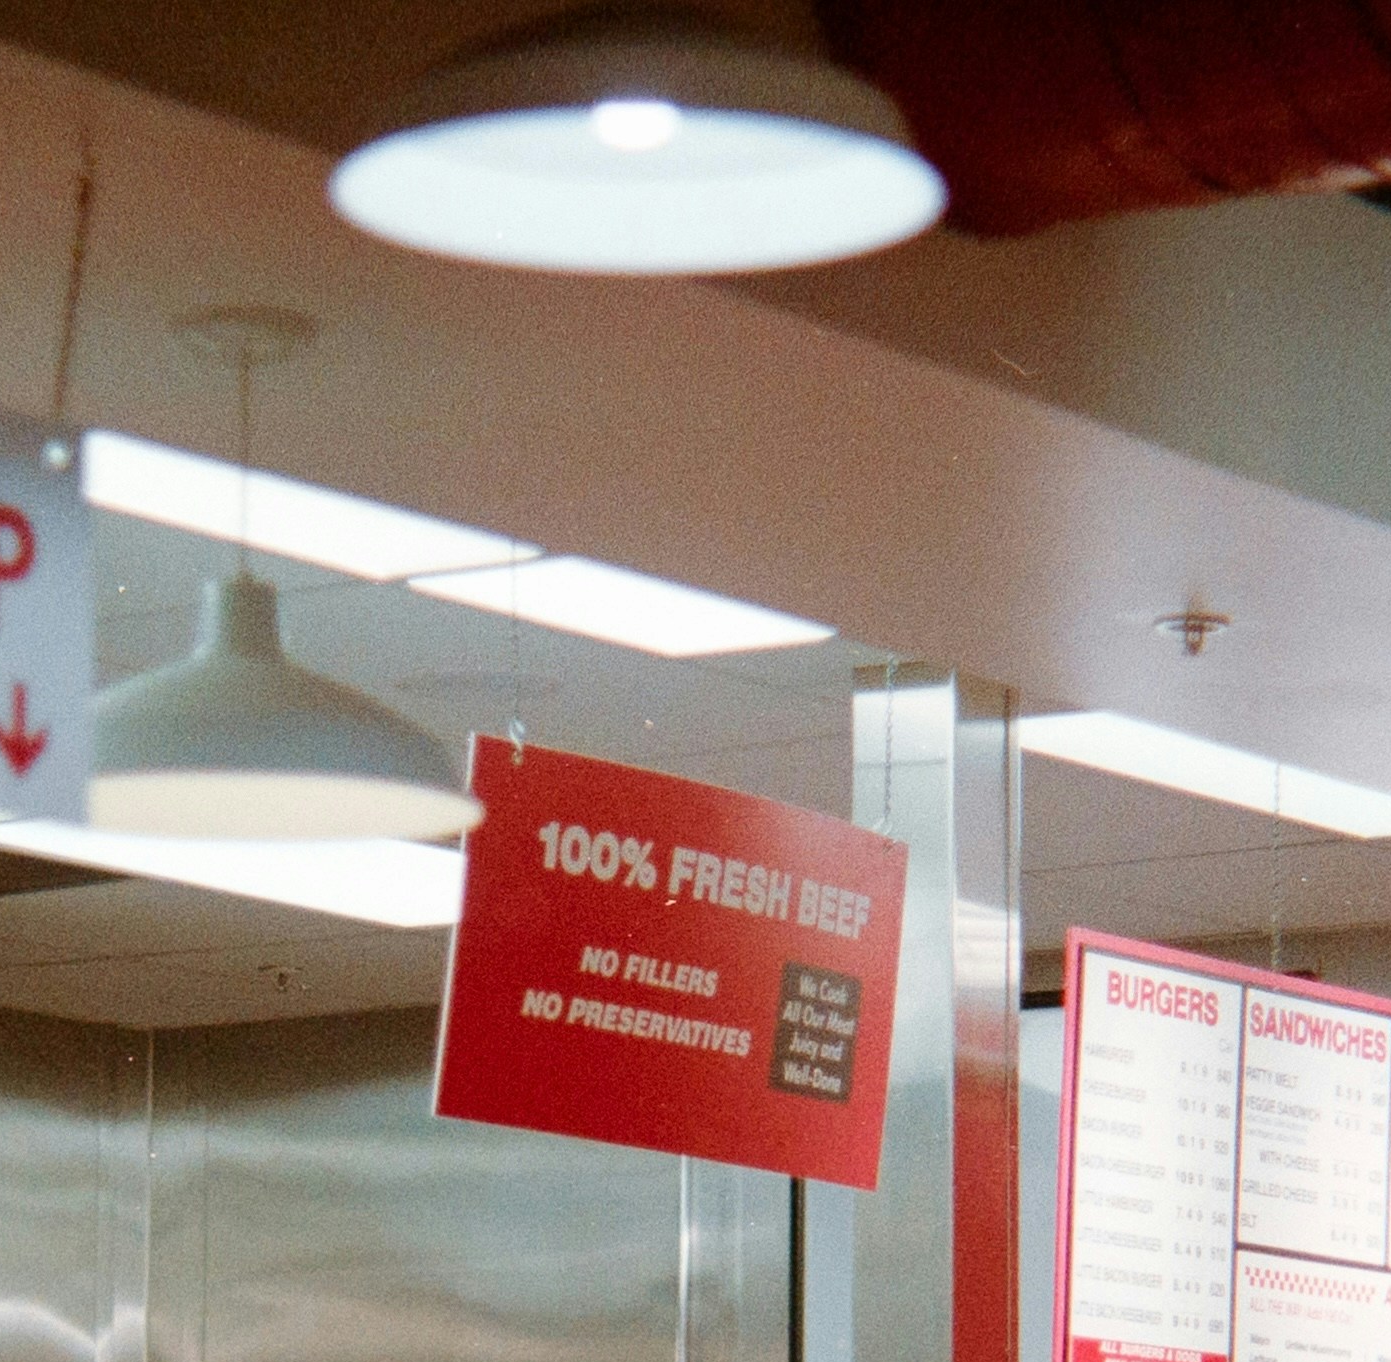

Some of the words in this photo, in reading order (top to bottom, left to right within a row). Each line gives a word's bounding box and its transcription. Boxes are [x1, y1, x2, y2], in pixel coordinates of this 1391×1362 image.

[538, 821, 657, 890] 100%
[668, 846, 793, 923] FRESH
[796, 878, 871, 940] BEEF
[580, 946, 618, 977] NO
[623, 954, 720, 999] FILLERS
[798, 975, 817, 999] We
[1107, 971, 1219, 1027] BURGERS
[521, 989, 564, 1022] NO
[566, 997, 752, 1058] PRESERVATIVES
[783, 1003, 802, 1023] All
[1250, 1003, 1387, 1063] SANDWICHES
